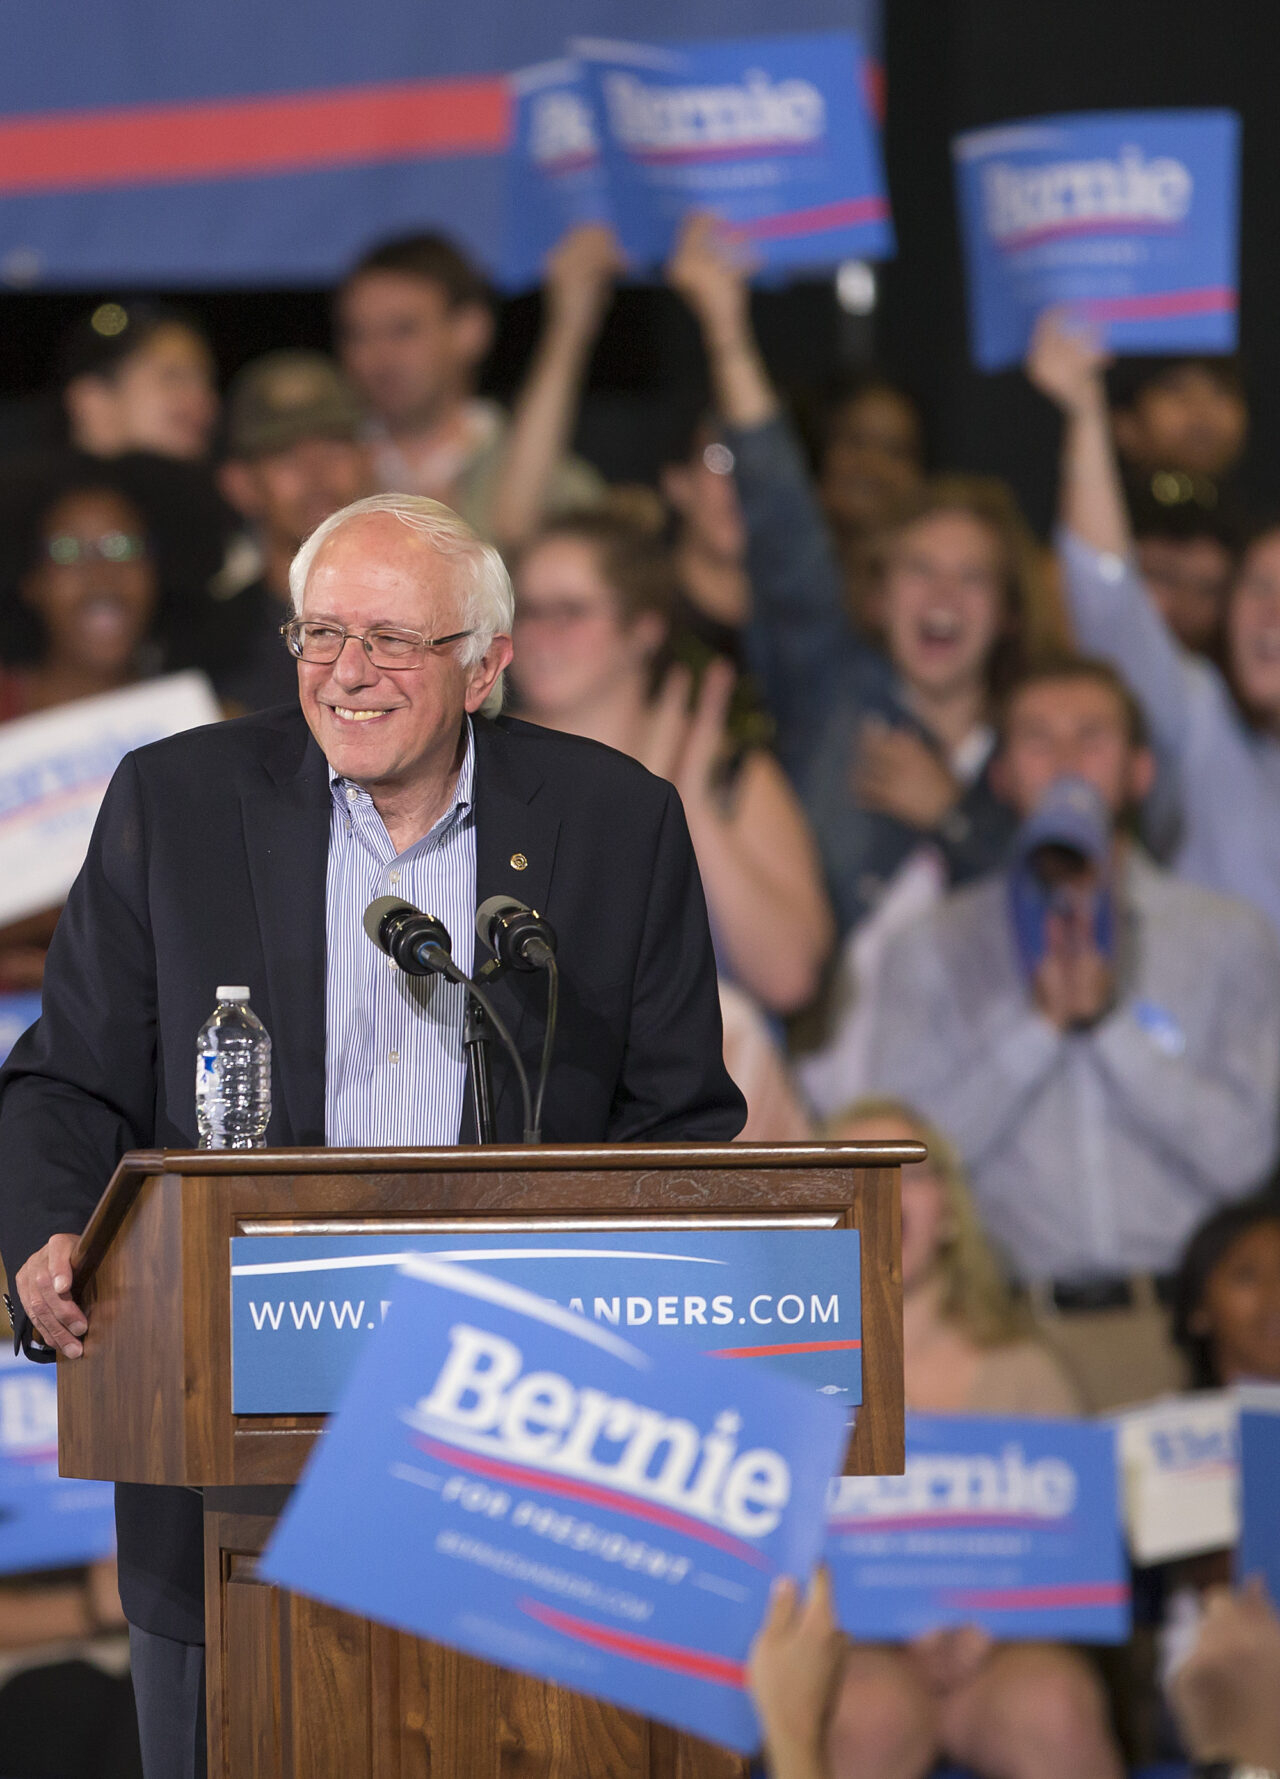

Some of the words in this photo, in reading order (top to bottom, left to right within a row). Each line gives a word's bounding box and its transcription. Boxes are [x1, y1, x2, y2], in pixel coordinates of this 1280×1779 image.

[416, 1322, 791, 1538] Bernie
[440, 1473, 512, 1521] FOR
[511, 1499, 694, 1586] PRESIDENT
